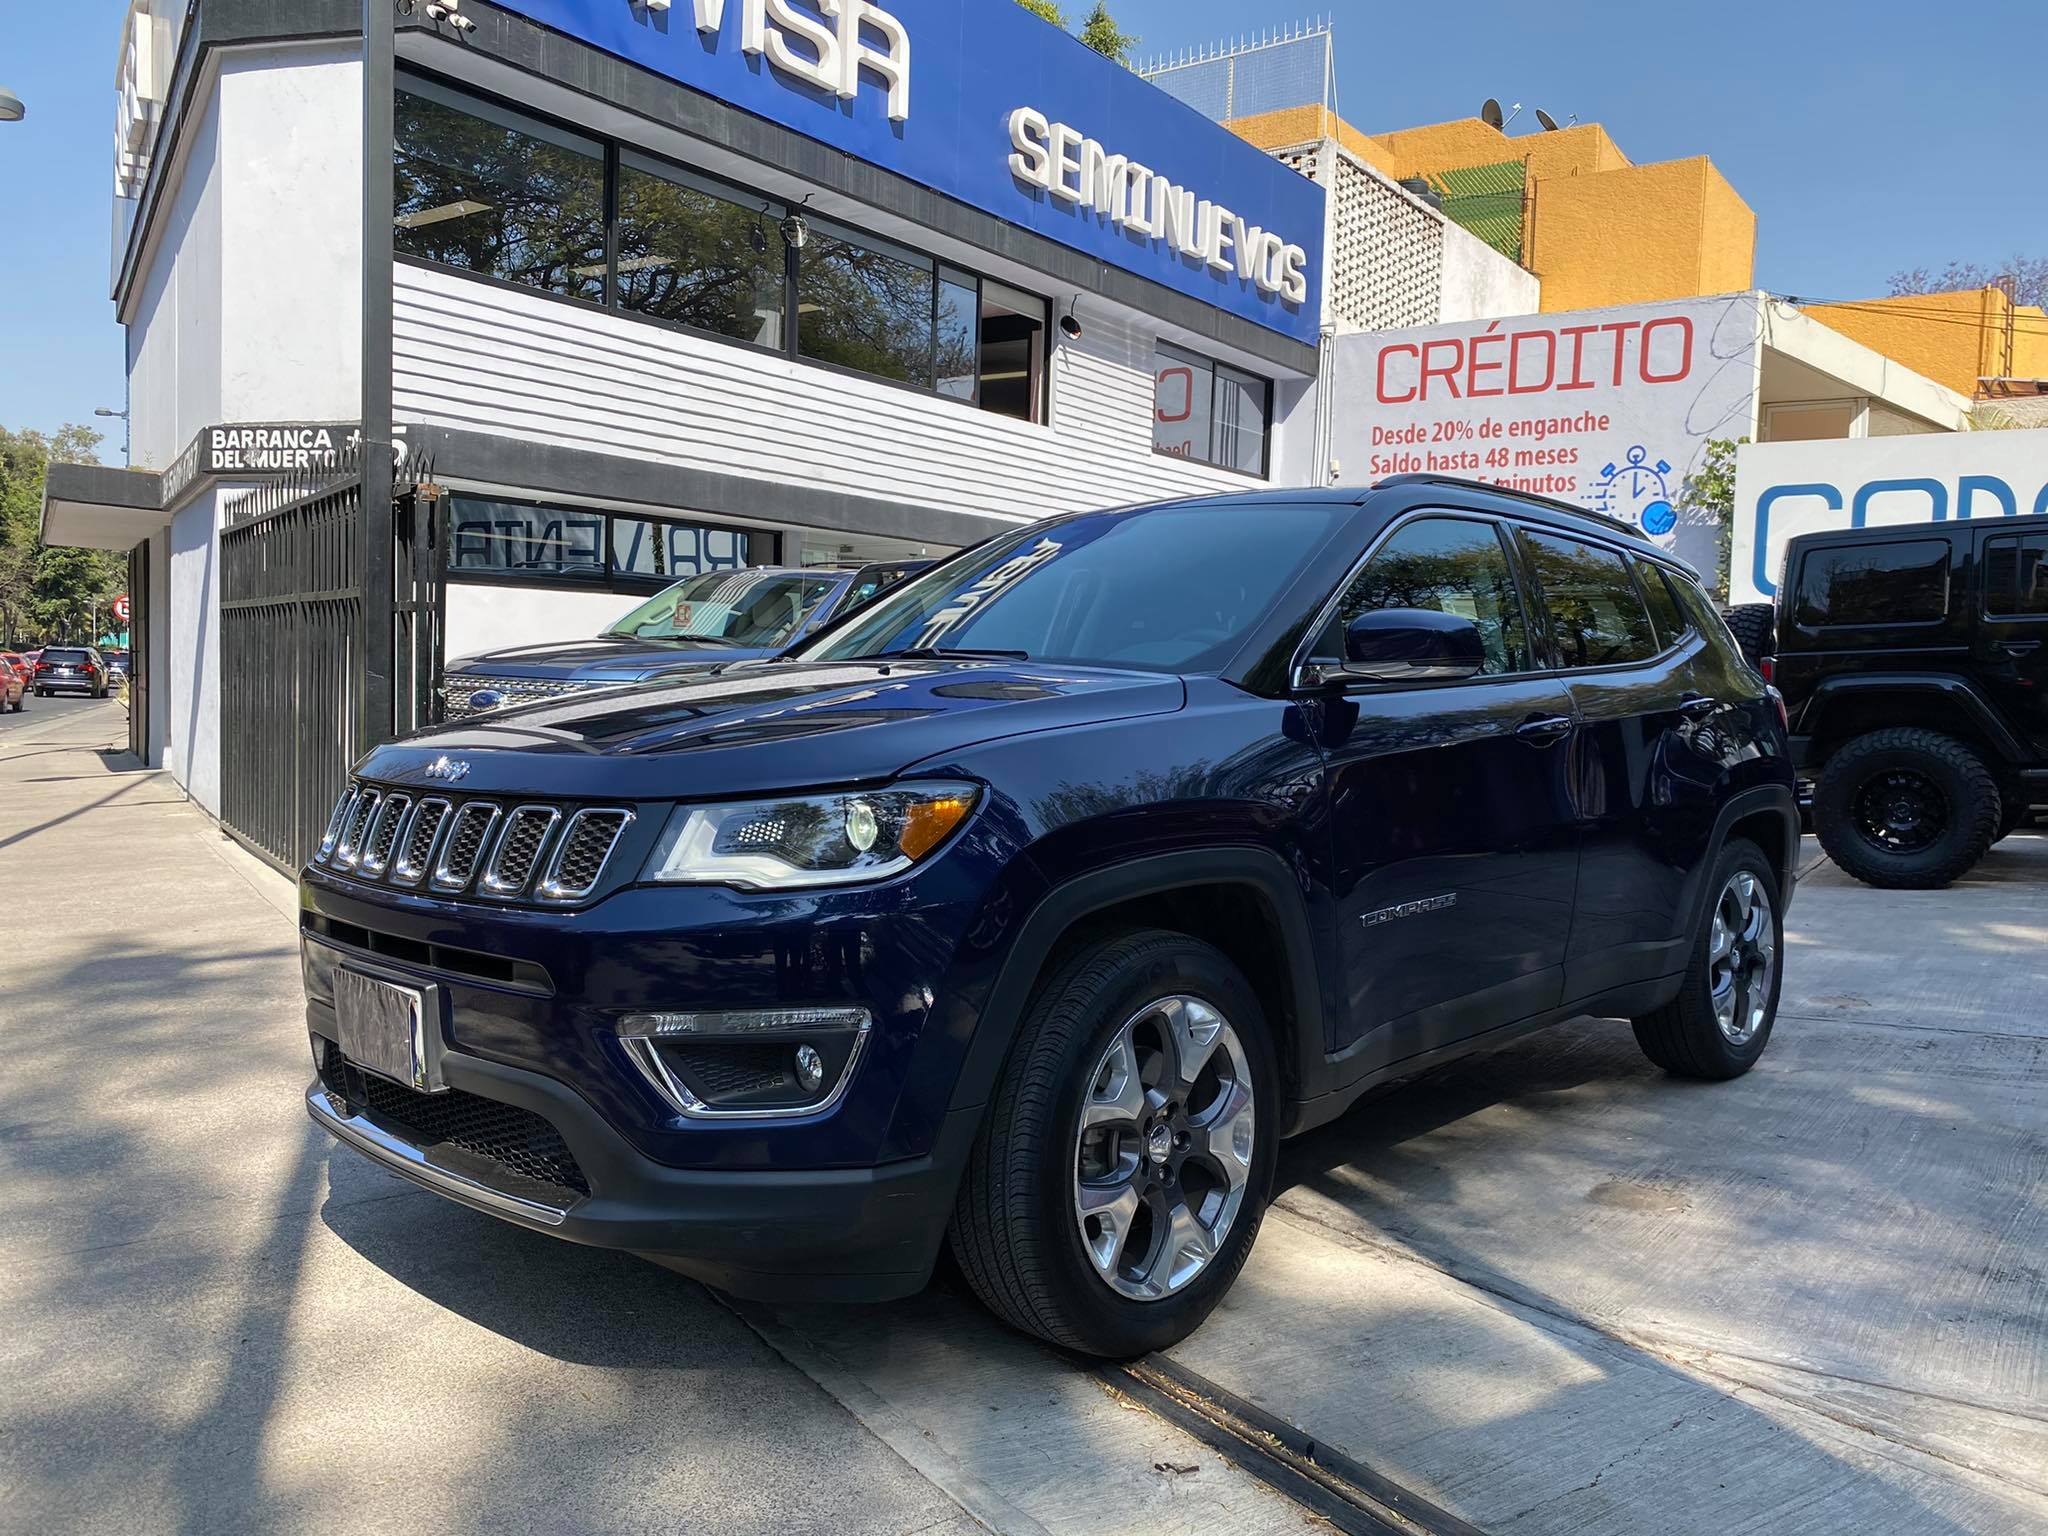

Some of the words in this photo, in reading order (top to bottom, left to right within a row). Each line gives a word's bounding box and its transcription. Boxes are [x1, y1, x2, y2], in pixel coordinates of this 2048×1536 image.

[1008, 106, 1307, 304] SEMINUEVOS
[1376, 316, 1694, 405] CRÉDITO
[212, 429, 332, 449] BARRANCA
[1372, 423, 1427, 446] Desde
[1432, 420, 1473, 443] 20%
[1478, 417, 1501, 439] de
[1508, 411, 1610, 441] enganche
[212, 450, 244, 468] DEL
[1370, 452, 1422, 475] Saldo
[1427, 450, 1480, 471] hasta
[1485, 448, 1510, 468] 48
[1514, 446, 1579, 467] meses
